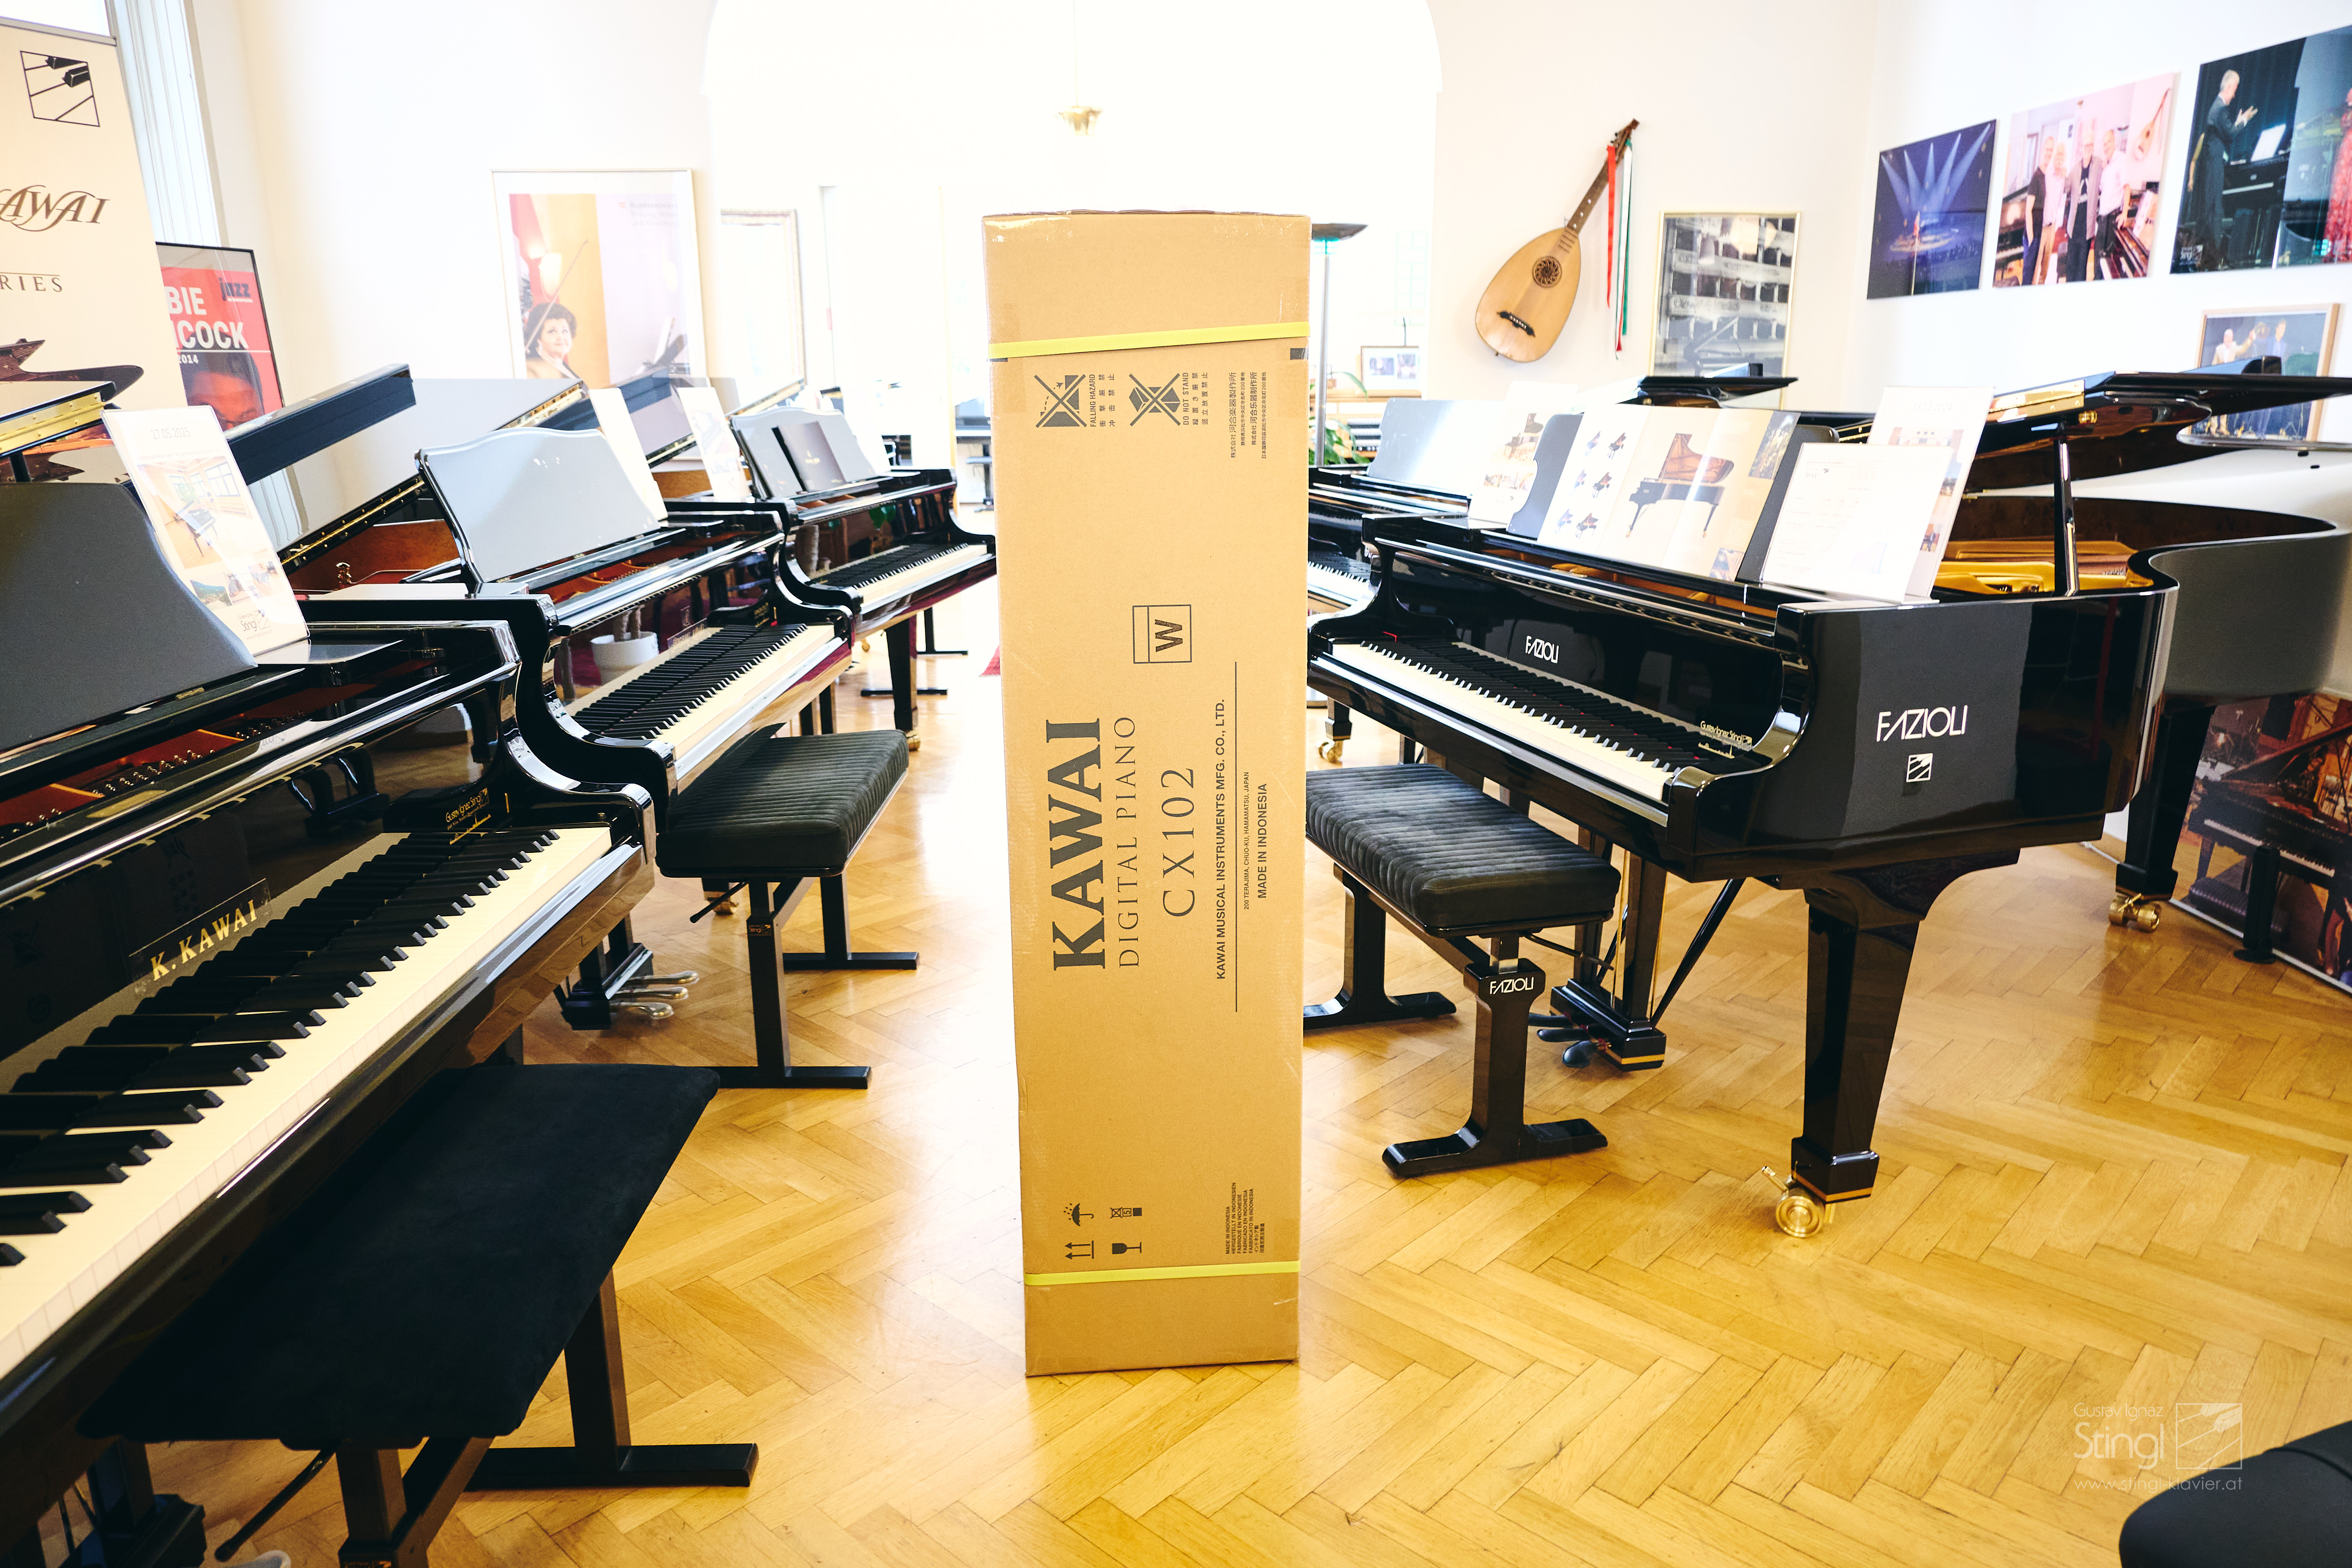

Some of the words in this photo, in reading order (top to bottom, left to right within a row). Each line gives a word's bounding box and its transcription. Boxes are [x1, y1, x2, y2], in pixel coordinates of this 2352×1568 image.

[0, 185, 110, 232] AWAI
[218, 277, 250, 301] jazz
[171, 320, 249, 349] COCK
[150, 427, 191, 440] 27.05.2025
[1183, 416, 1189, 425] DO
[1154, 619, 1183, 652] W
[1525, 635, 1560, 664] FAZIOLI
[1215, 700, 1224, 726] LTD.
[1876, 705, 1968, 743] FAZIOLI
[1216, 730, 1226, 755] CO.,
[1114, 717, 1137, 820] PIANO
[1216, 760, 1225, 789] MFG.
[1258, 783, 1267, 847] INDONESIA
[1046, 718, 1105, 971] KAWAI
[1161, 768, 1195, 917] CX102
[1216, 793, 1225, 881] INSTRUMENTS
[1258, 851, 1266, 862] IN
[1258, 866, 1266, 898] MADE
[1116, 837, 1139, 968] DIGITAL
[1217, 884, 1225, 938] MUSICAL
[1217, 941, 1225, 979] KAWAI
[1489, 976, 1534, 995] FAZIOLI
